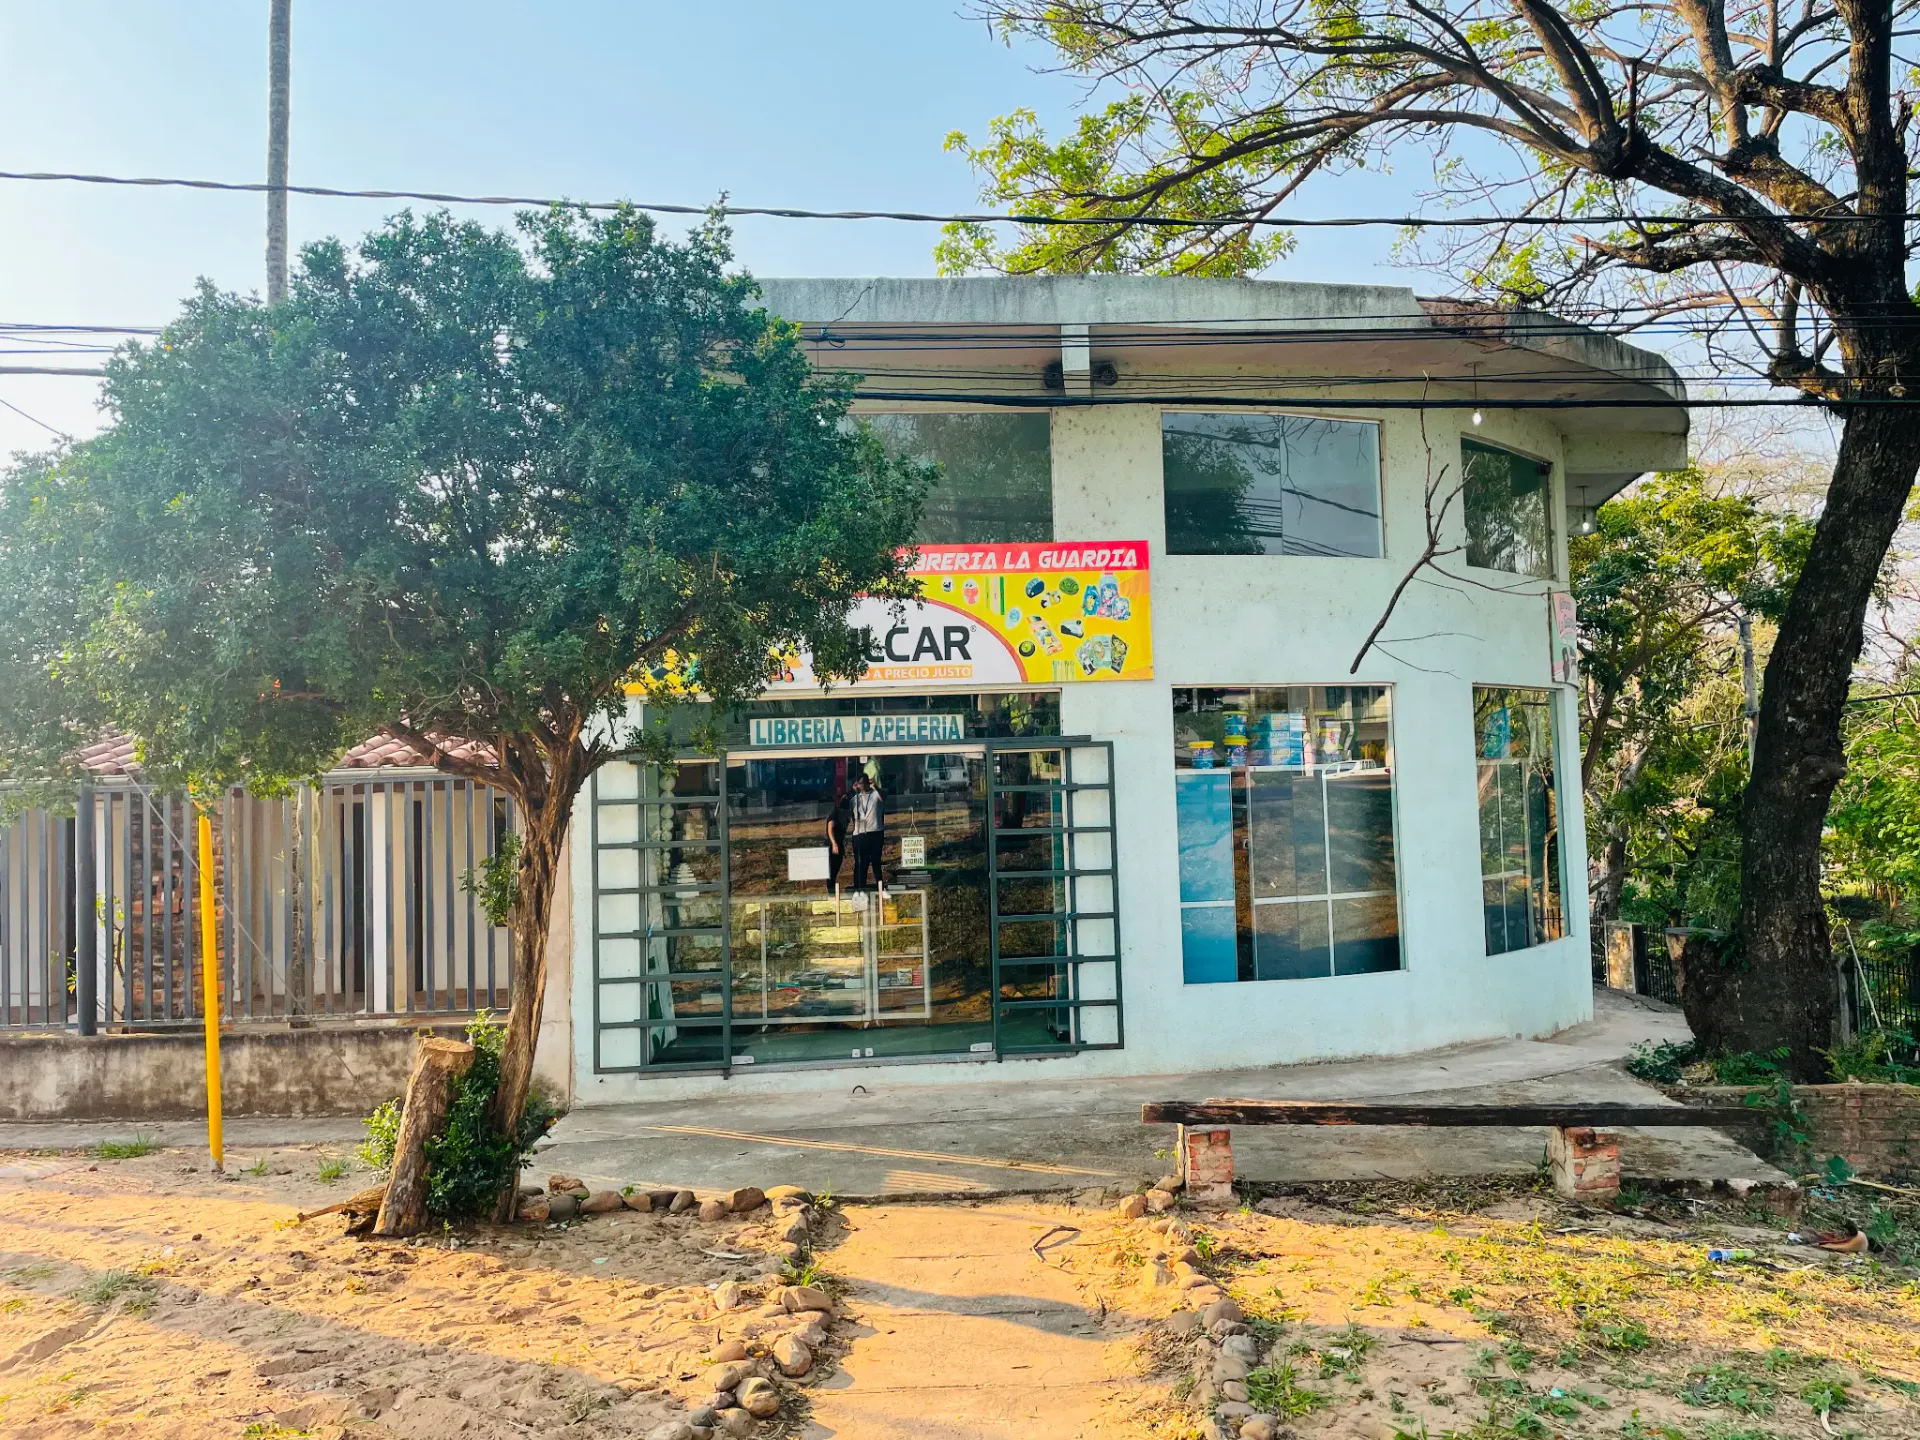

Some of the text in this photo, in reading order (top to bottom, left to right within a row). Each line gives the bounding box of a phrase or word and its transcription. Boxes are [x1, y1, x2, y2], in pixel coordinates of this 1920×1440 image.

[1003, 551, 1031, 569] LA
[1038, 549, 1137, 568] GUARDIA
[873, 668, 882, 678] A
[885, 667, 930, 679] PRECIO
[932, 666, 972, 677] JUSTO
[756, 715, 961, 744] LIBRERIA PAPELERIA
